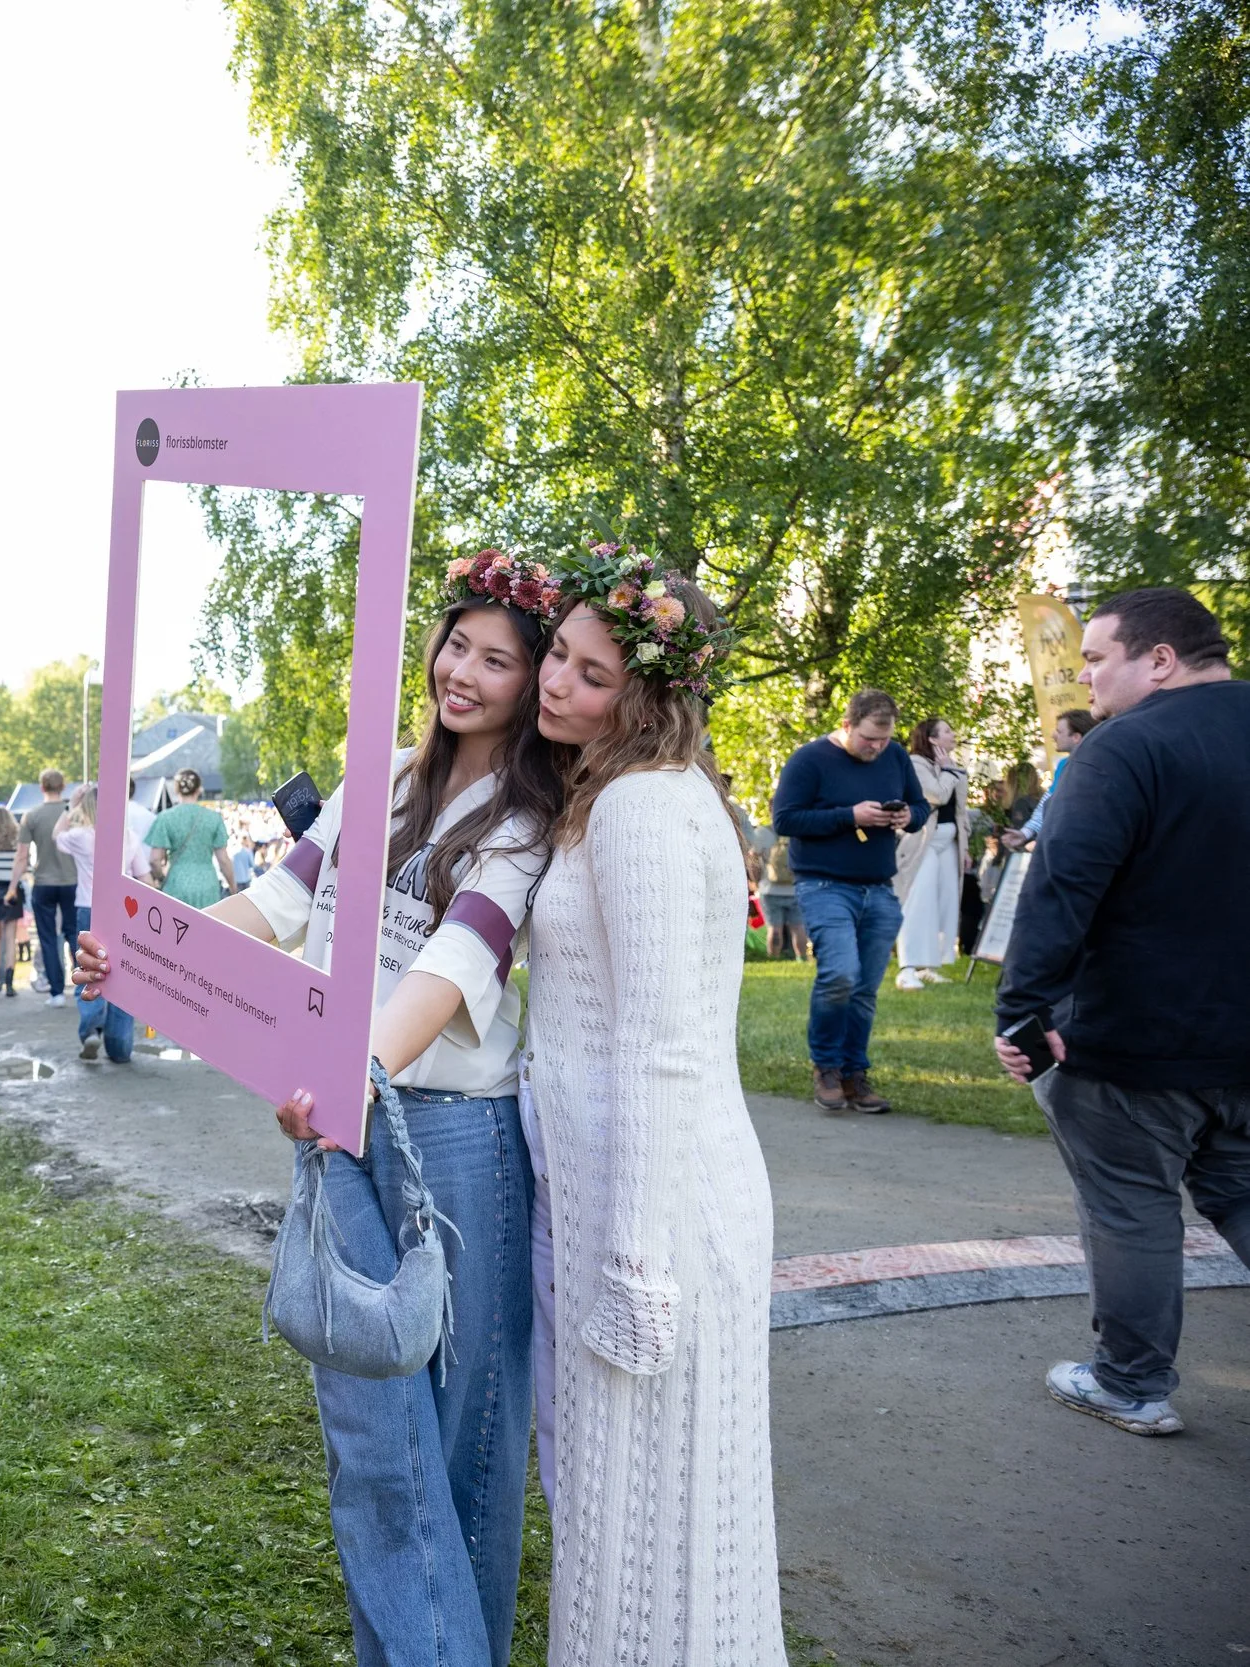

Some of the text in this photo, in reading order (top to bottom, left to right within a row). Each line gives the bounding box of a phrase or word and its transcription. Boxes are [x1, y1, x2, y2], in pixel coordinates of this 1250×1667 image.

[165, 435, 229, 451] florissblomster
[286, 787, 311, 810] 19:52
[120, 958, 210, 1018] #floriss #florissblomster
[121, 932, 278, 1029] florissblomster Pynt deg med blomster!
